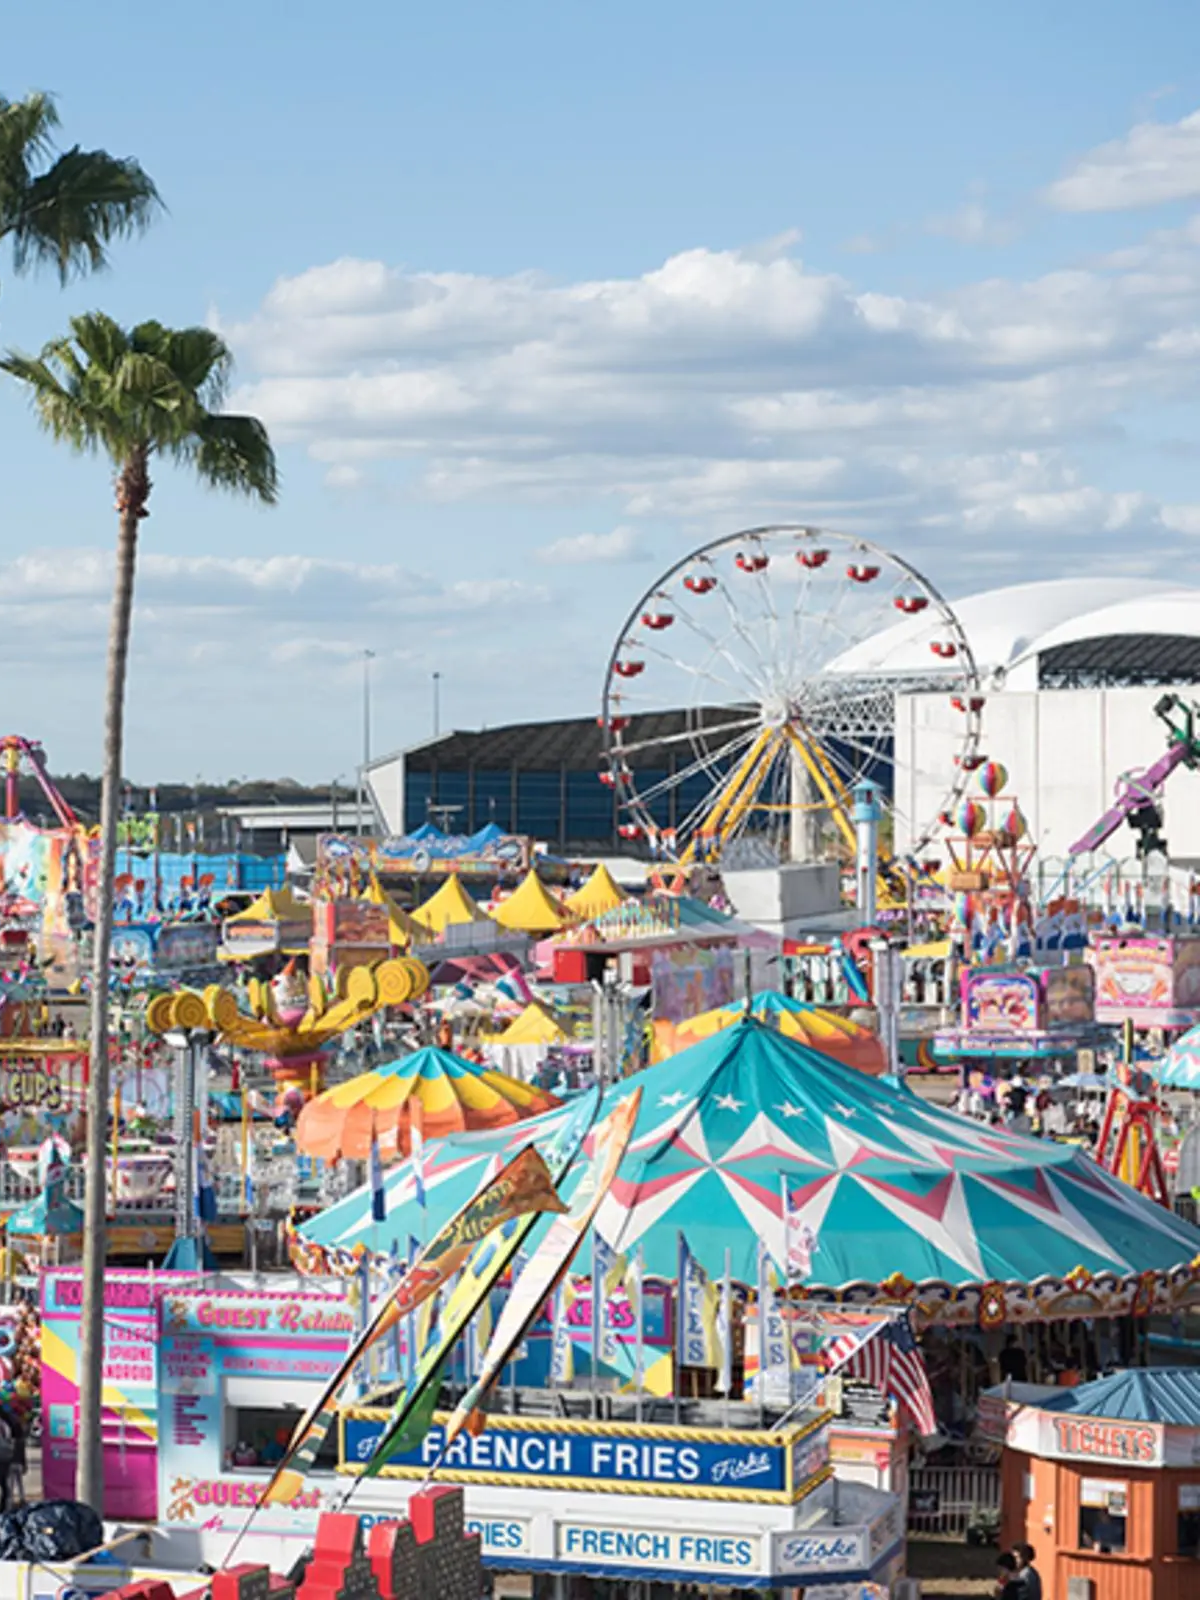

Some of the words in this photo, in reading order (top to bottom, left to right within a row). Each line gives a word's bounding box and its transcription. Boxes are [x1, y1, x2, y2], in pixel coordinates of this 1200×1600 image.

[7, 1071, 61, 1108] CUPS
[196, 1301, 272, 1330] GUEST
[422, 1432, 571, 1471] FRENCH
[591, 1442, 700, 1480] FRIES
[1057, 1420, 1155, 1460] TICKETS
[565, 1527, 670, 1560] FRENCH
[678, 1534, 752, 1565] FRIES
